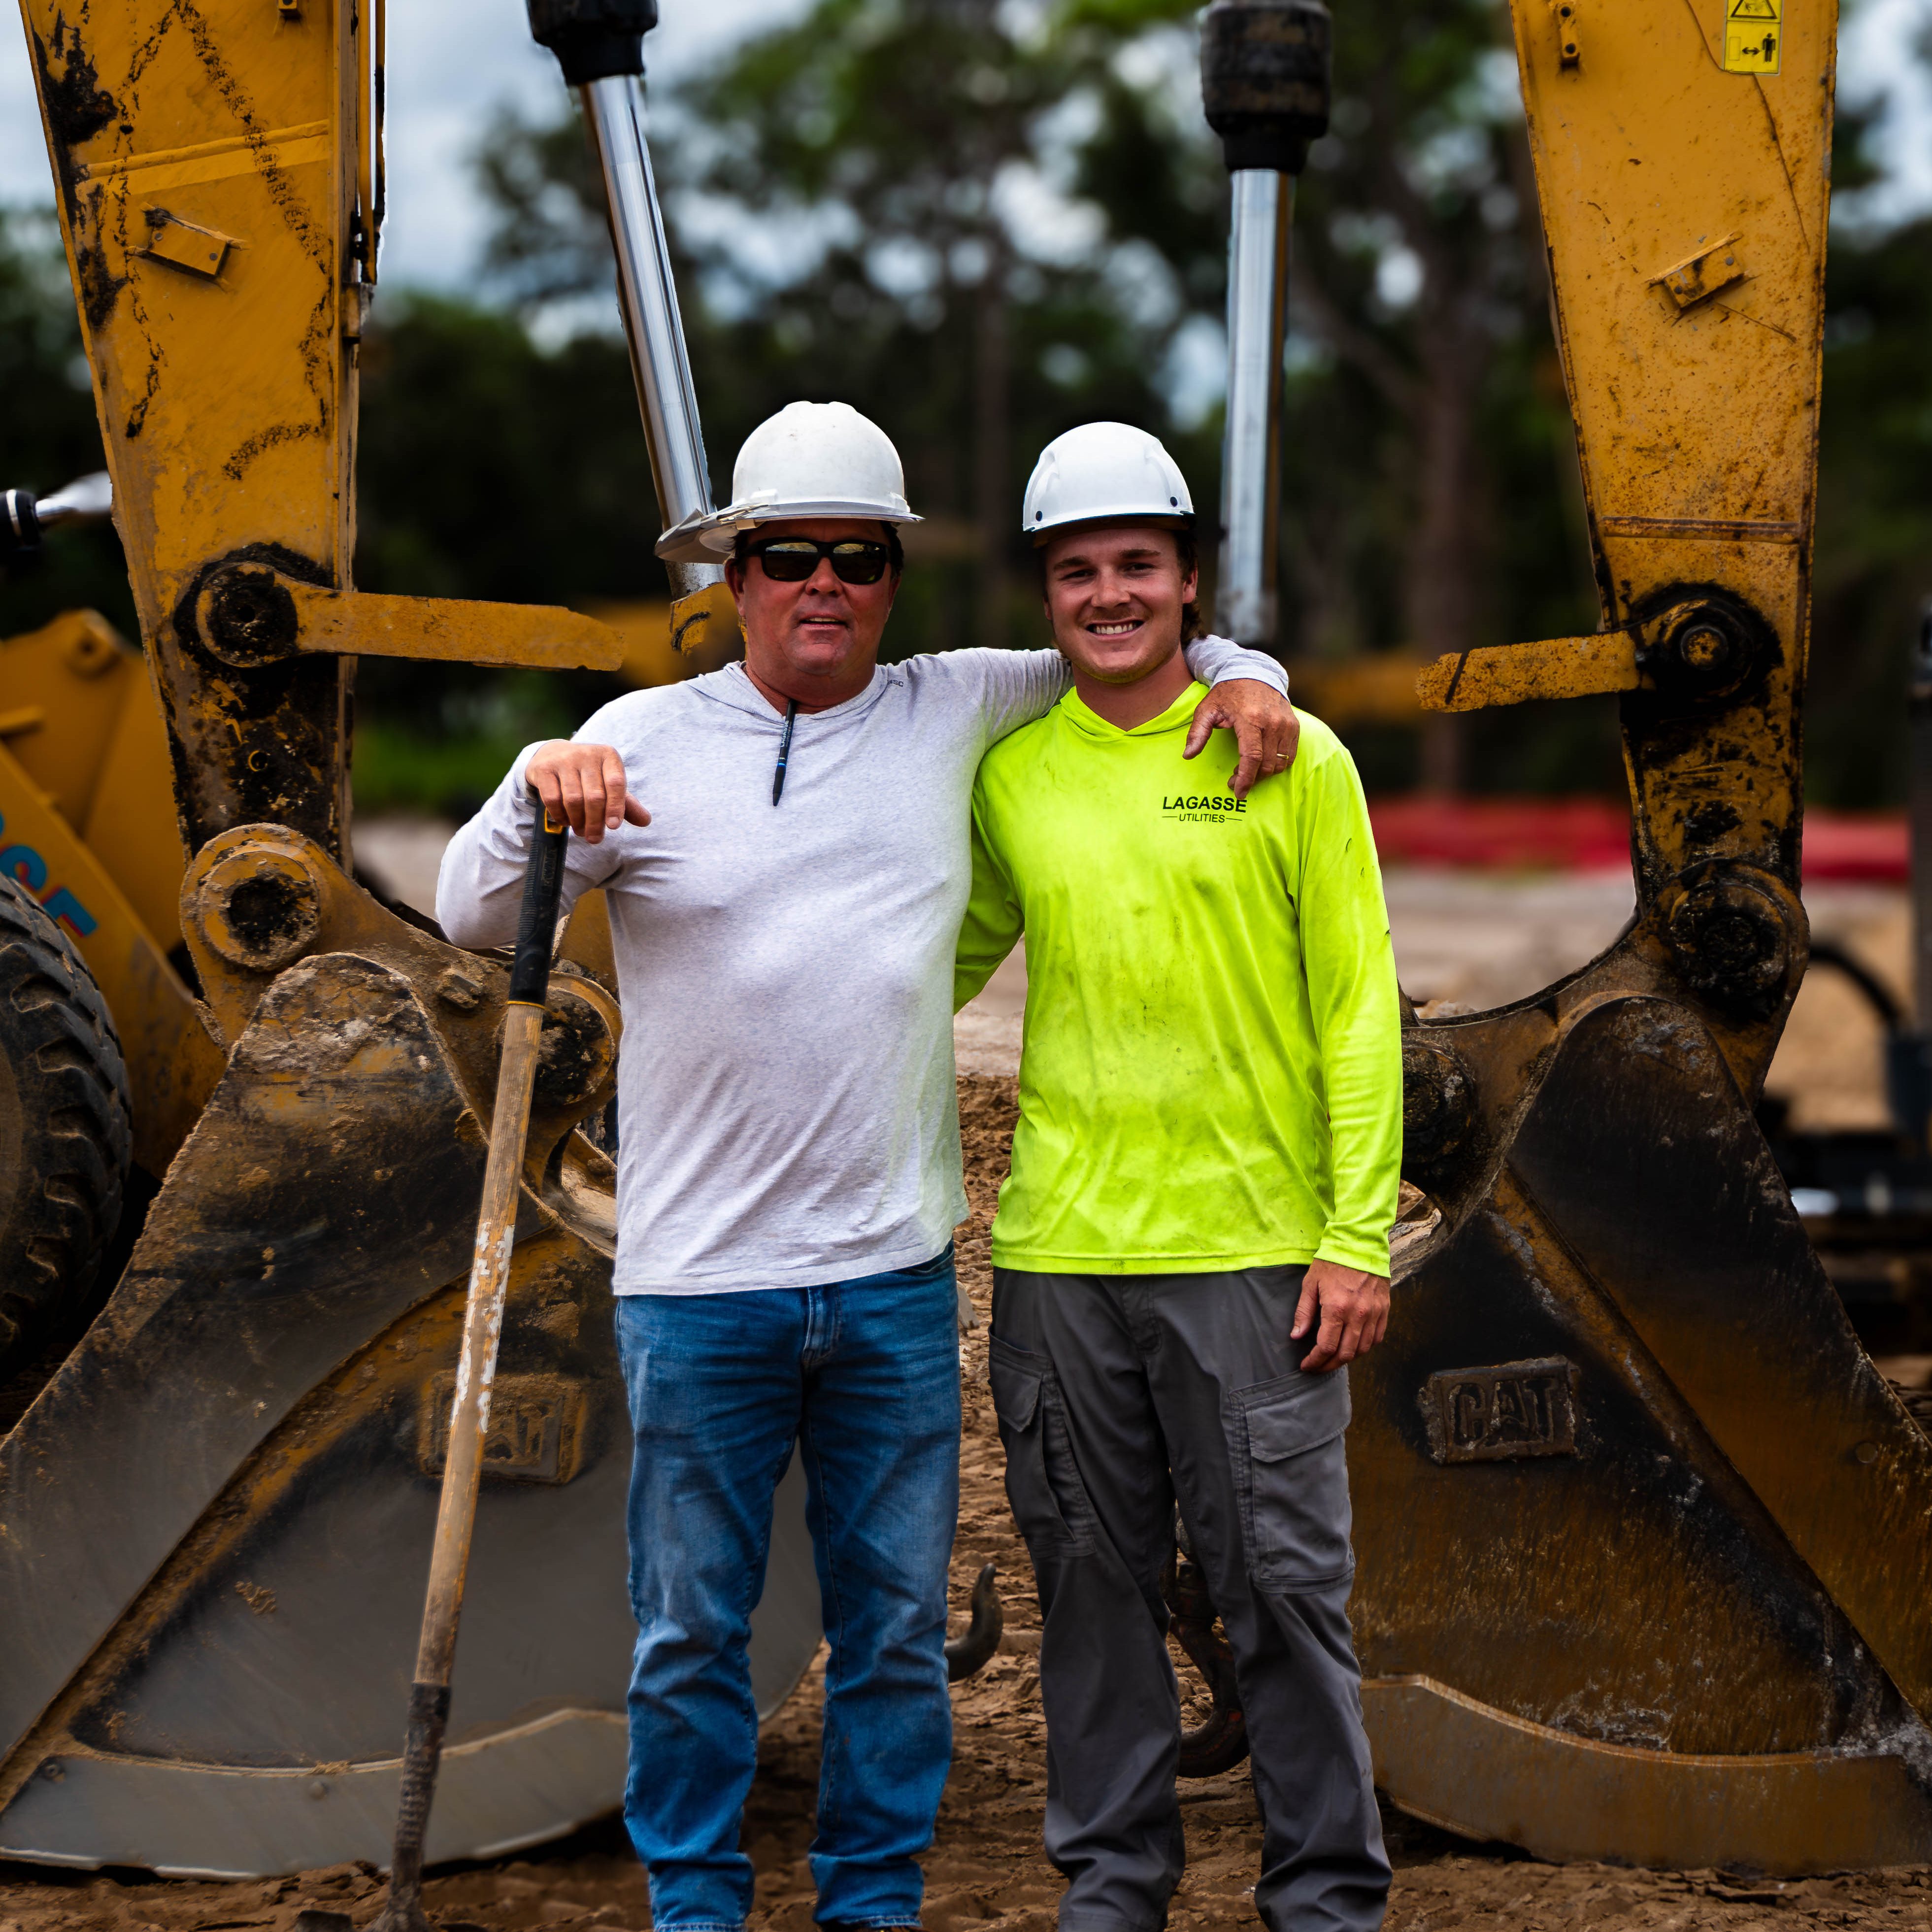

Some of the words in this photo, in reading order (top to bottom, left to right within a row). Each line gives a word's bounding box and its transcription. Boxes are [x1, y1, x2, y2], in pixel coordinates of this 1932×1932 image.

[1163, 796, 1247, 813] LAGASSE
[1179, 813, 1225, 823] UTILITIES
[1450, 1378, 1557, 1447] CAT
